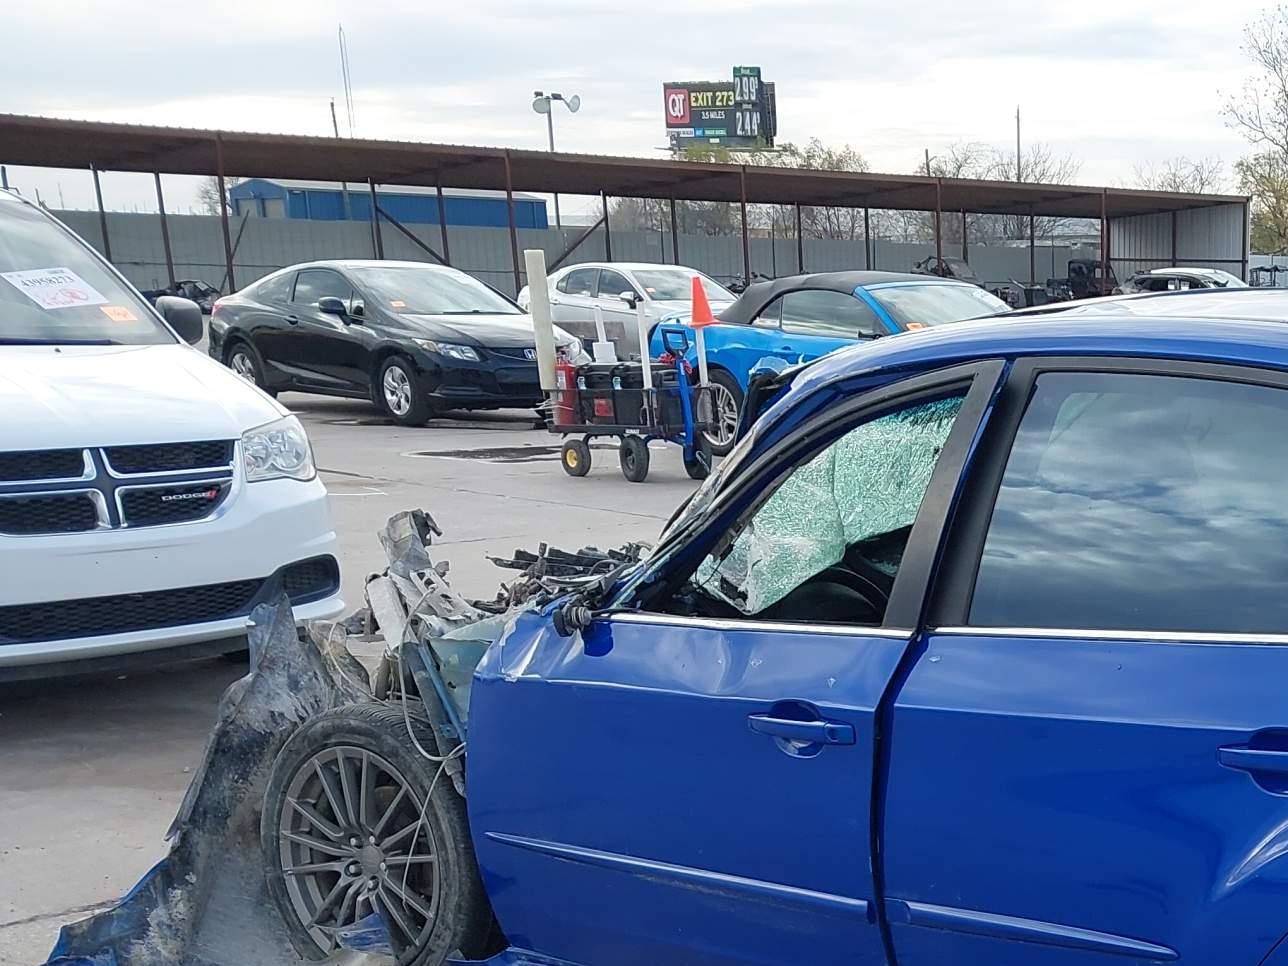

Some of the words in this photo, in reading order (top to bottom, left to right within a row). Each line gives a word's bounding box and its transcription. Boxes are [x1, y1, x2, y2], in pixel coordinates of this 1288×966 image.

[668, 93, 685, 118] QT
[690, 92, 713, 107] EXIT
[715, 91, 735, 106] 273
[161, 491, 210, 502] DODGE
